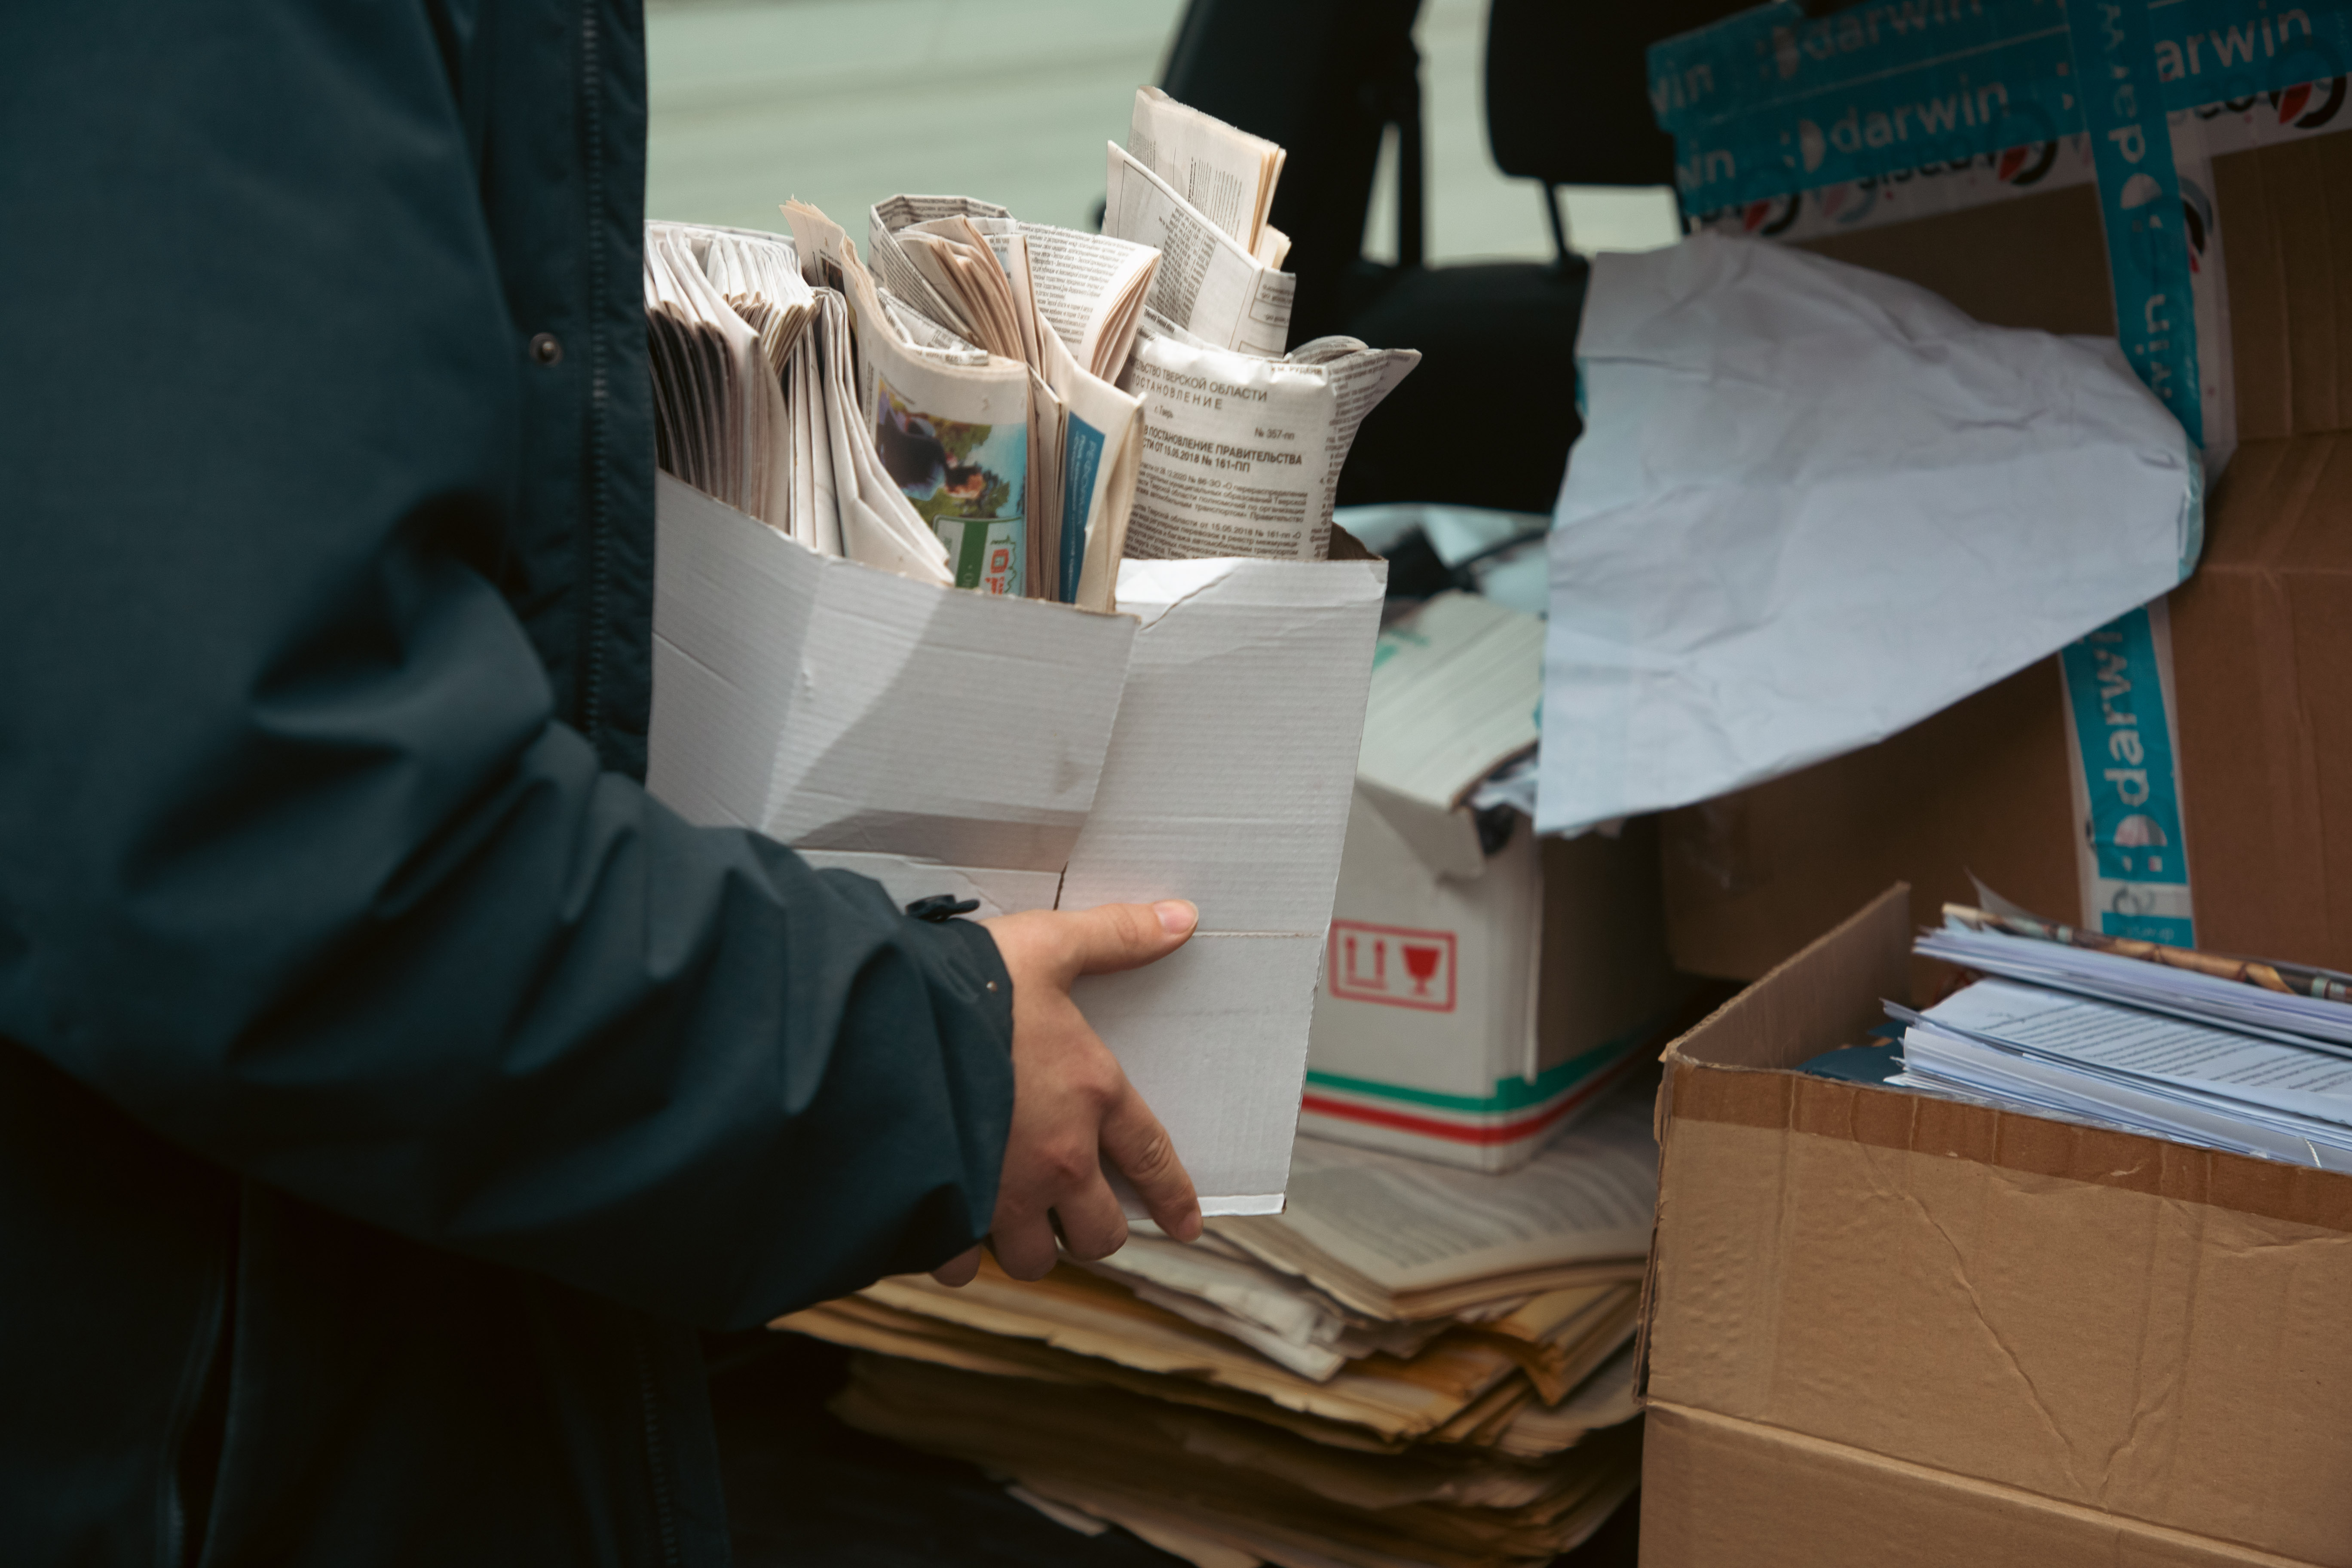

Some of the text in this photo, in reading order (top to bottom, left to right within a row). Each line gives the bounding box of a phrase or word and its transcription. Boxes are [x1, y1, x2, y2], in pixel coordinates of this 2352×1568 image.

[1829, 72, 2012, 154] darwin
[1132, 373, 1222, 410] ПОСТАНОВЛЕНИЕ
[1162, 368, 1207, 391] ТВЕРСКОЙ
[1209, 381, 1268, 402] ОБЛАСТИ
[1148, 426, 1214, 453] ПОСТАНОВЛЕНИЕ
[1216, 444, 1302, 465] ПРАВИТЕЛЬСТВА
[1254, 426, 1265, 438] №
[1155, 441, 1164, 453] ОТ
[1201, 455, 1212, 466] №
[1216, 458, 1250, 472] 161-ПП
